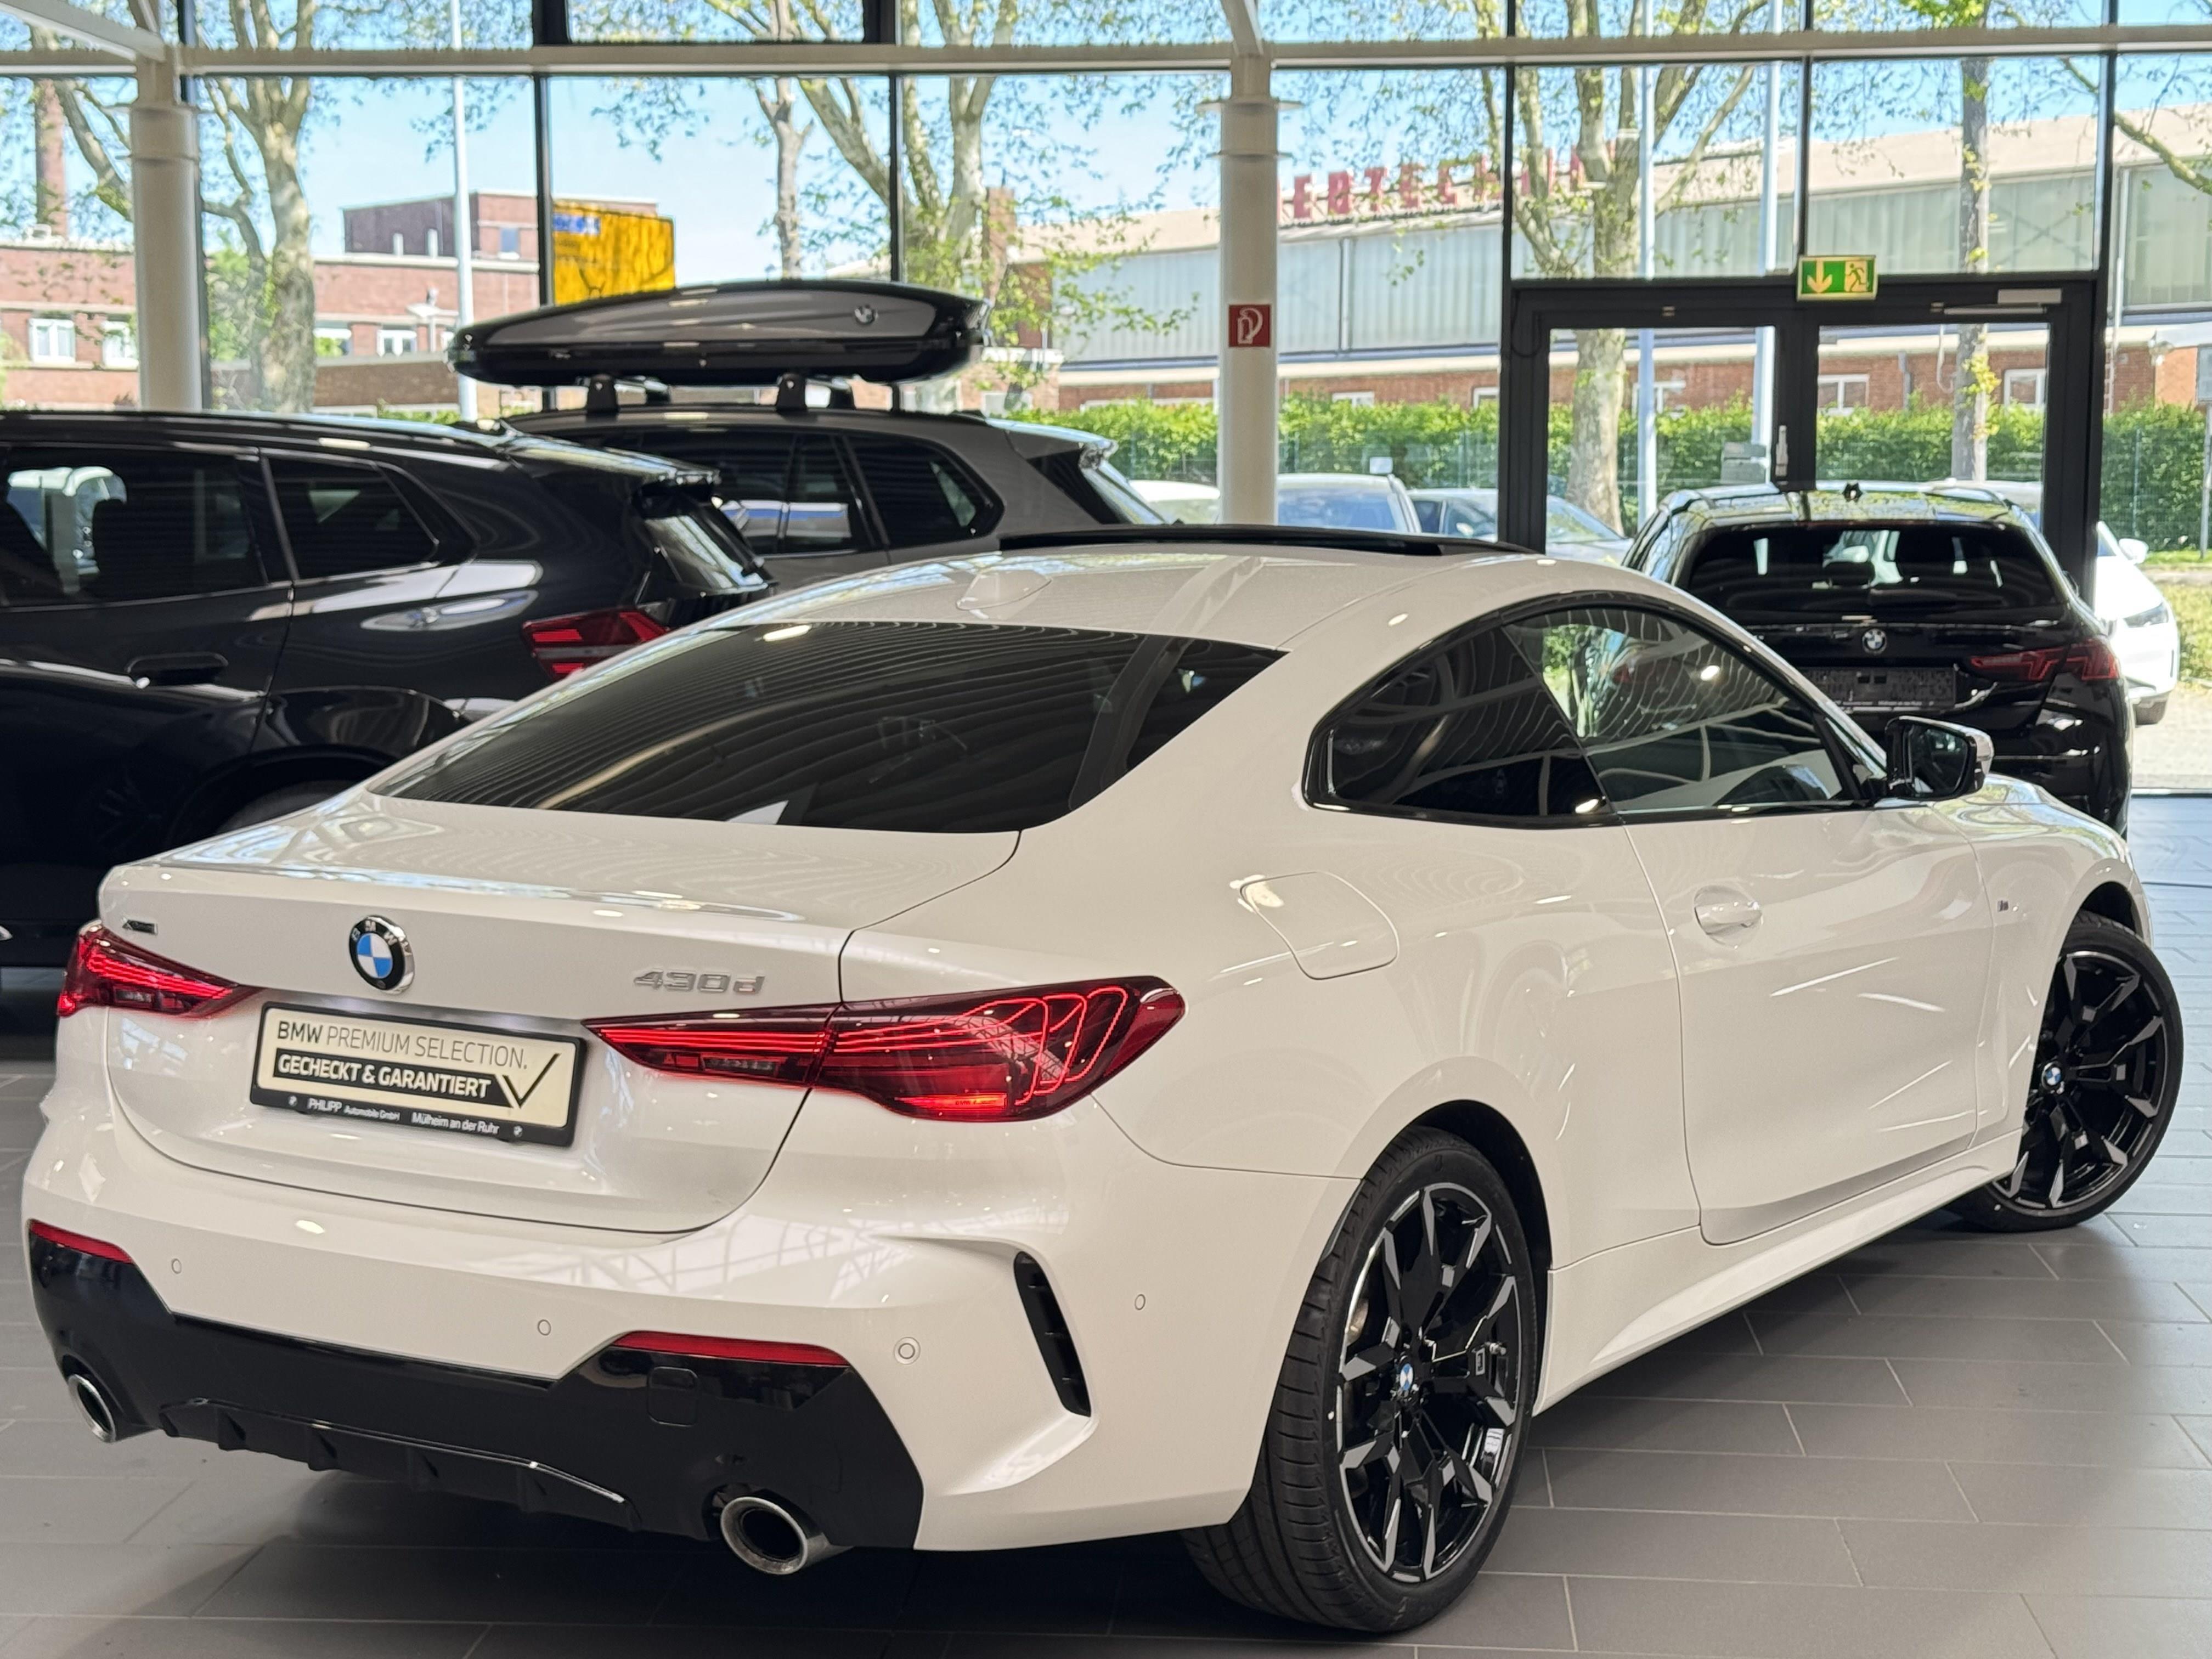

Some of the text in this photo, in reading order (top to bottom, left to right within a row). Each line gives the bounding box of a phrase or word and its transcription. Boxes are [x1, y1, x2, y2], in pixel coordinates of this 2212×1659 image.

[351, 920, 397, 946] BMW
[634, 969, 765, 992] 430d
[278, 1021, 527, 1069] BMW PREMIUM SELECTION.
[278, 1054, 491, 1098] GECHECKT & GARANTIERT
[307, 1098, 500, 1134] PHILIPP Automobile GmbH Mülheim an der Ruhr
